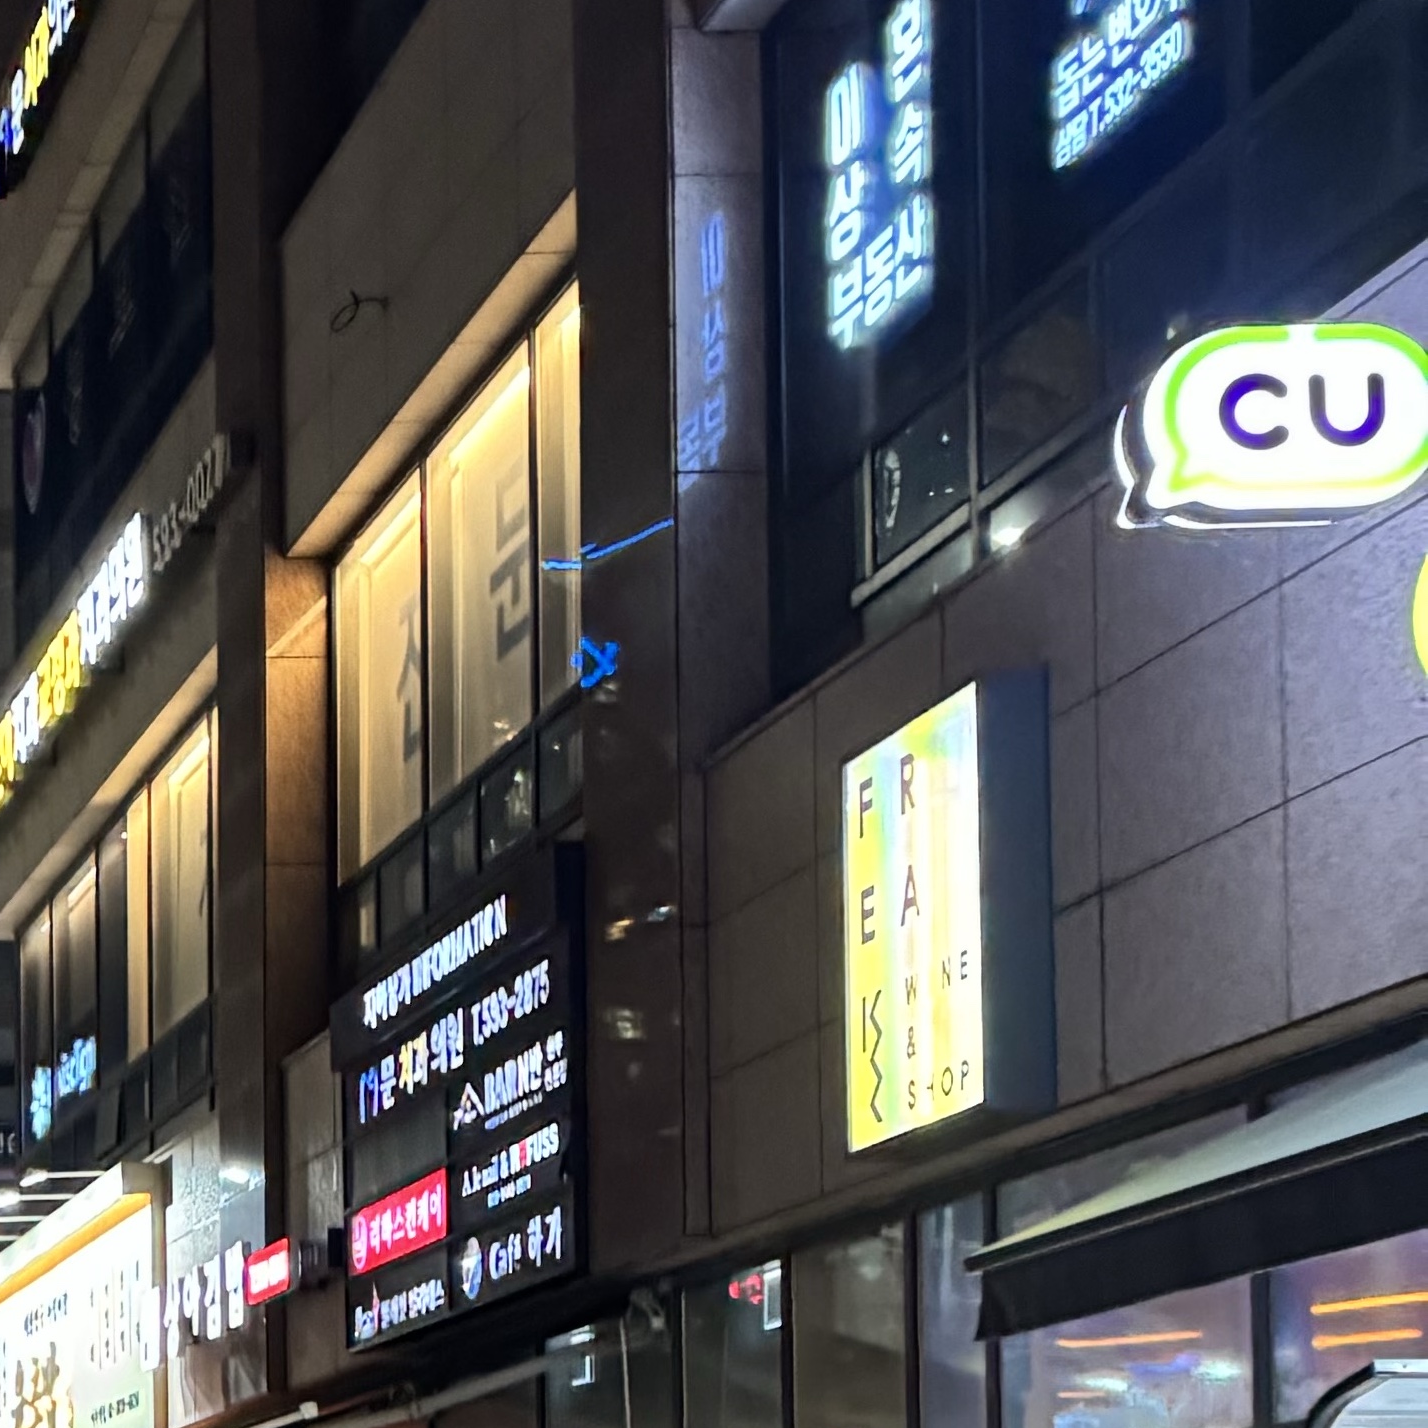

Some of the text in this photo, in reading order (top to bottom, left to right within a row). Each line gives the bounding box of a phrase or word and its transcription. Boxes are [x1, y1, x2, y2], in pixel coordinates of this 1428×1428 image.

[830, 193, 927, 348] 부동산
[1219, 372, 1386, 451] CU
[411, 893, 508, 997] INFORMATION
[905, 949, 969, 1006] WNE
